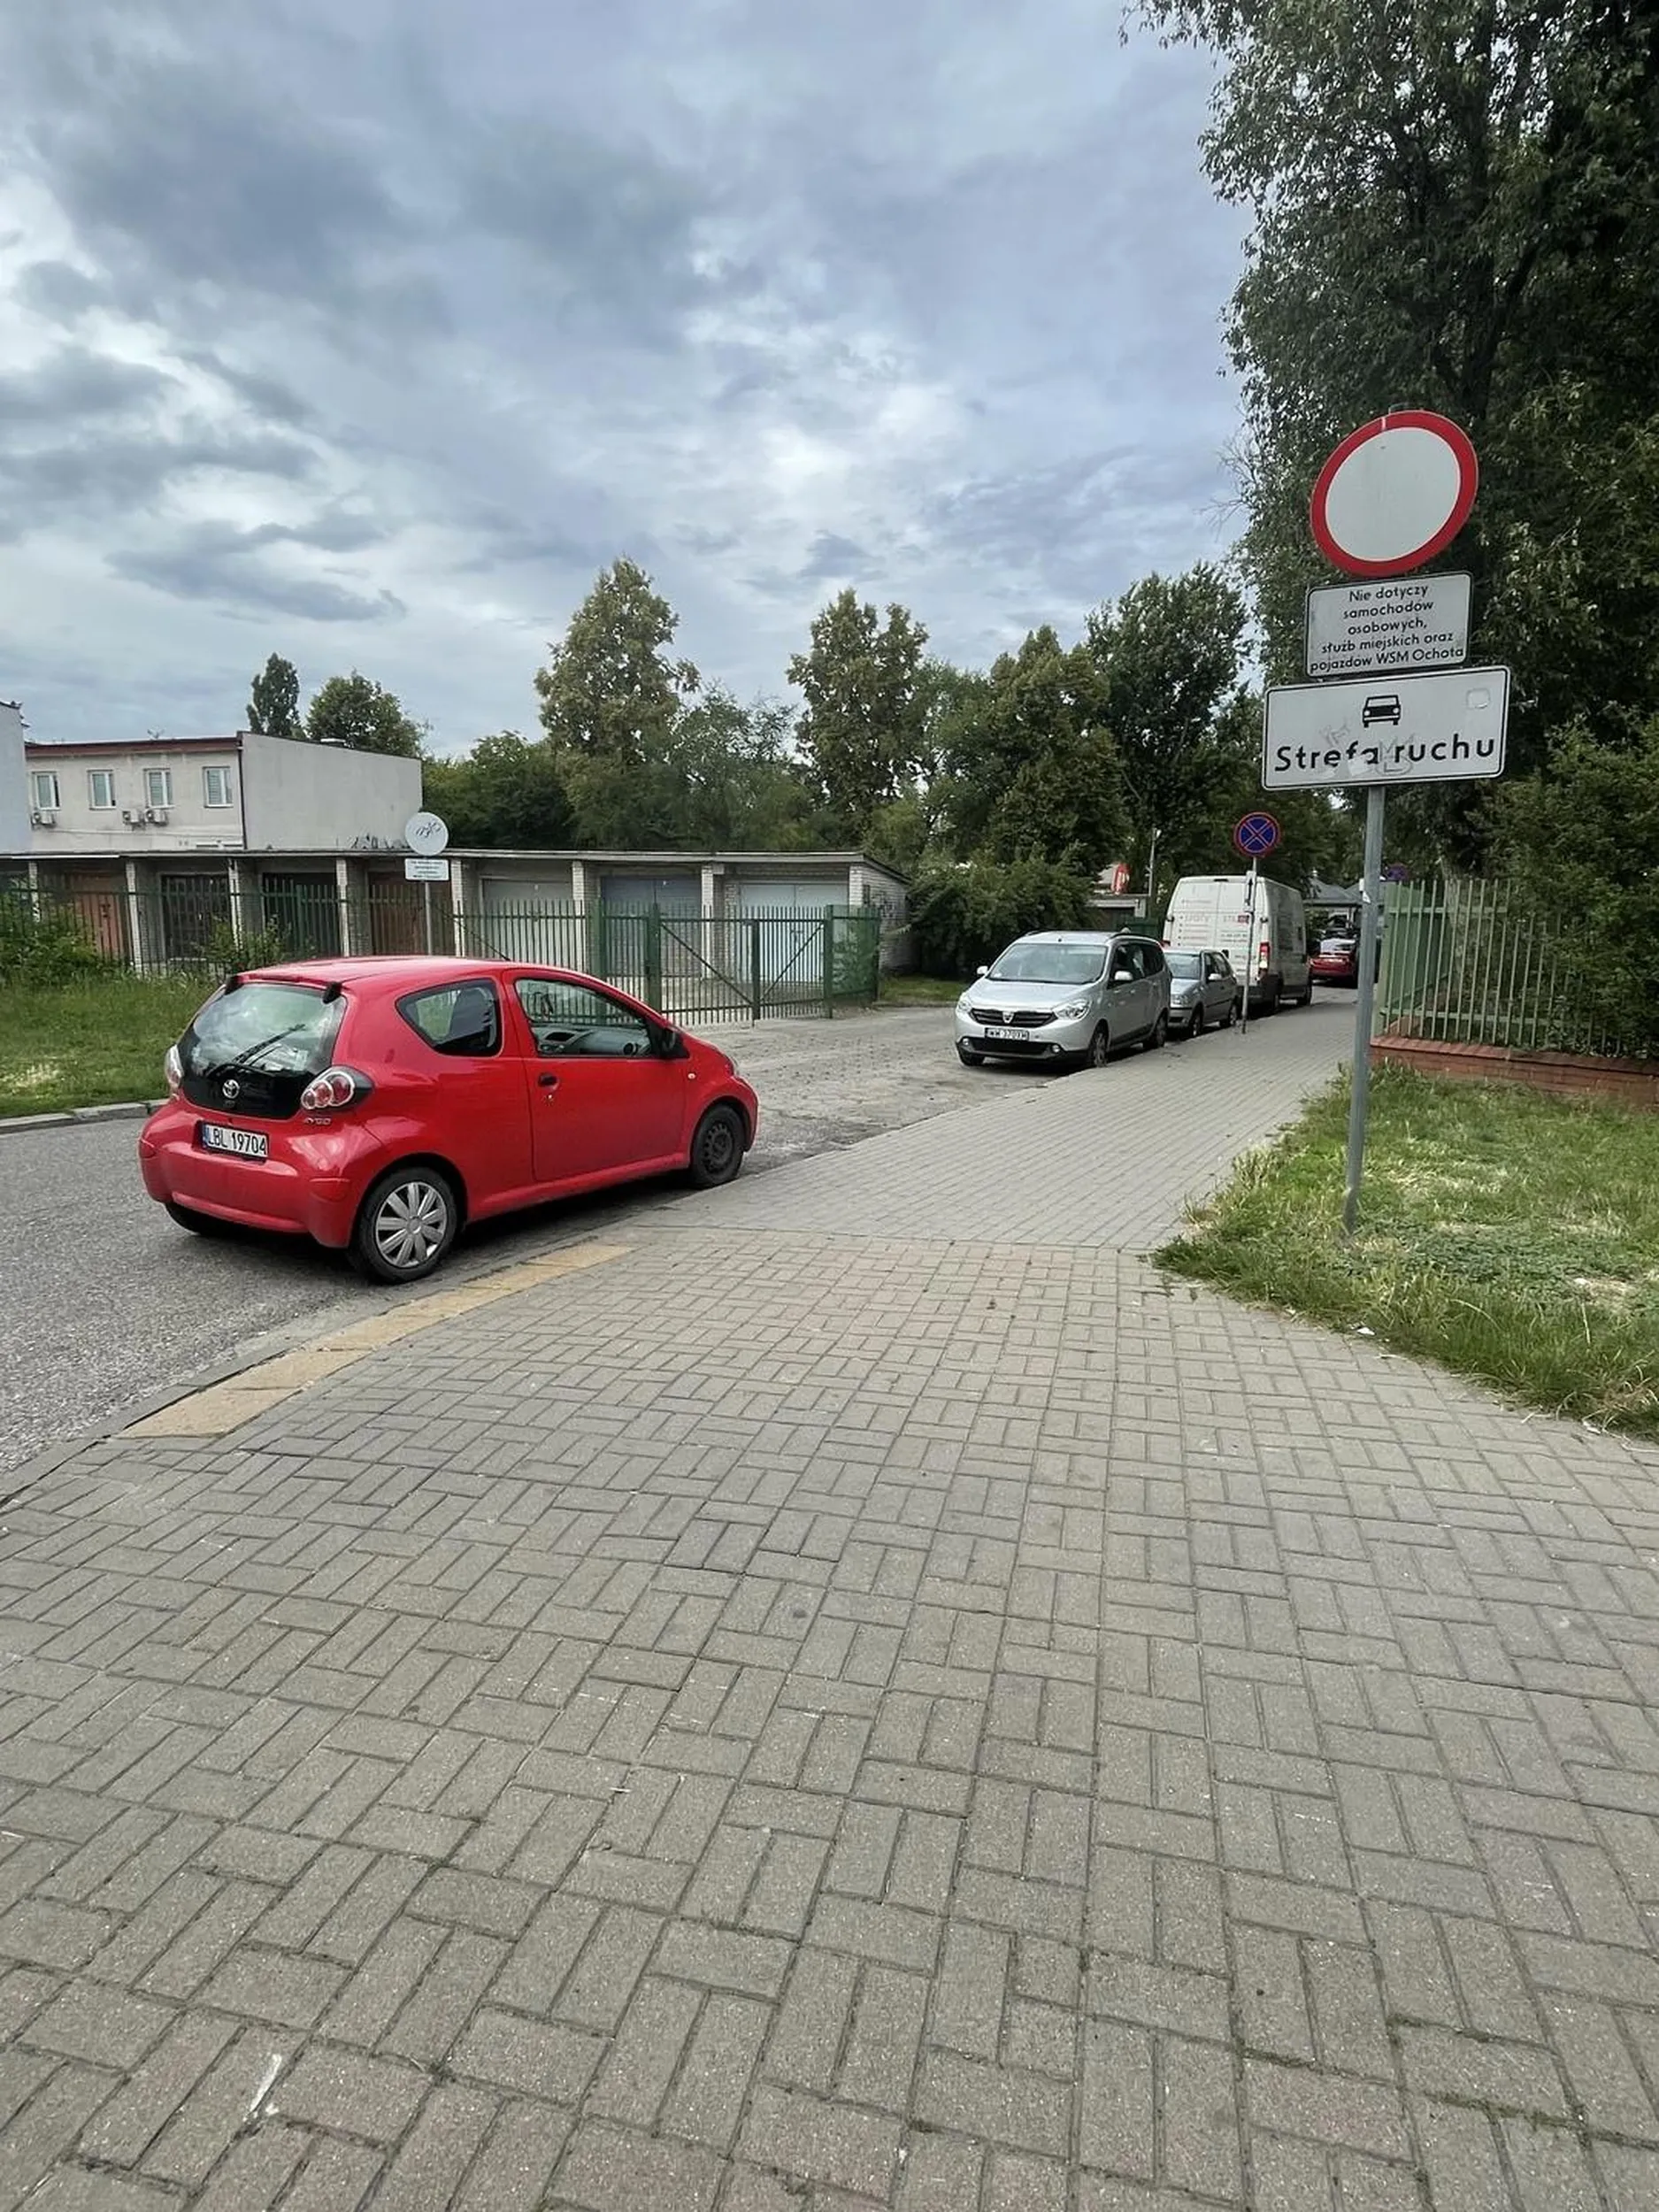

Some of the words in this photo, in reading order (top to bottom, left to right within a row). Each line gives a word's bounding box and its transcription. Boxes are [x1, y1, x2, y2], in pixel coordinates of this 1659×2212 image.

[1349, 590, 1371, 602] Nie
[1375, 586, 1428, 600] dotyczy
[1343, 601, 1434, 619] samochodów
[1348, 617, 1427, 635] osobowych,
[1321, 639, 1356, 654] służb
[1359, 634, 1420, 651] miejskich
[1424, 632, 1454, 644] oraz
[1310, 657, 1372, 674] pojazdów
[1376, 651, 1409, 664] WSM
[1412, 647, 1463, 661] Ochota
[1274, 741, 1379, 772] Strefa
[1394, 733, 1494, 764] ruchu
[208, 1126, 228, 1148] LBL
[232, 1132, 267, 1155] 19704
